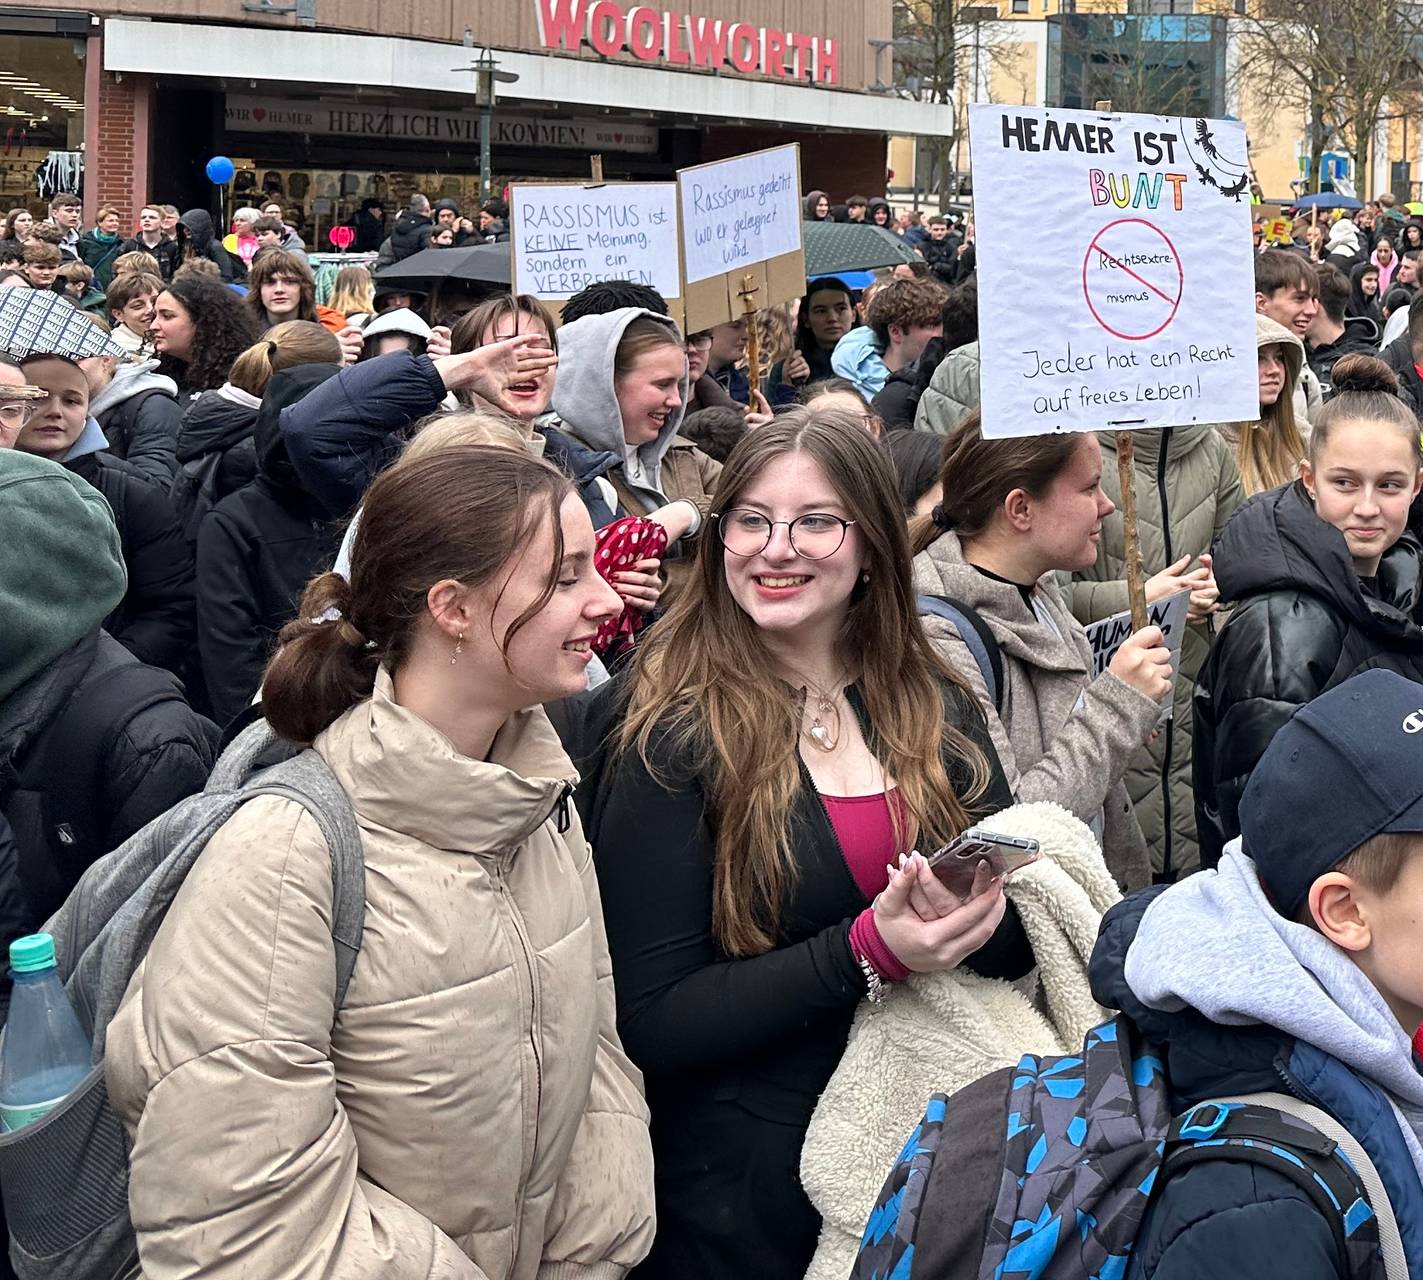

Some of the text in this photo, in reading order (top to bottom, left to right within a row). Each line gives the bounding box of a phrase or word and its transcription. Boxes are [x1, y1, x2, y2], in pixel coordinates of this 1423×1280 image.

[536, 0, 839, 84] WOOLWORTH
[226, 107, 313, 125] WIR HEMER
[328, 110, 585, 145] HERZLICH WILKOMMEN!
[1001, 114, 1178, 166] HEMER IST
[693, 172, 792, 217] Rassismus gedeiht
[1089, 168, 1187, 211] BUNT
[523, 203, 669, 229] RASSISMUS ist
[717, 222, 728, 239] er
[524, 233, 583, 252] KEINE
[526, 253, 628, 273] sondern ein
[1106, 291, 1150, 304] mismus
[1022, 341, 1235, 378] Jeder hat ein Recht
[1033, 375, 1201, 413] auf freies Leben!
[1086, 602, 1171, 650] HUMN
